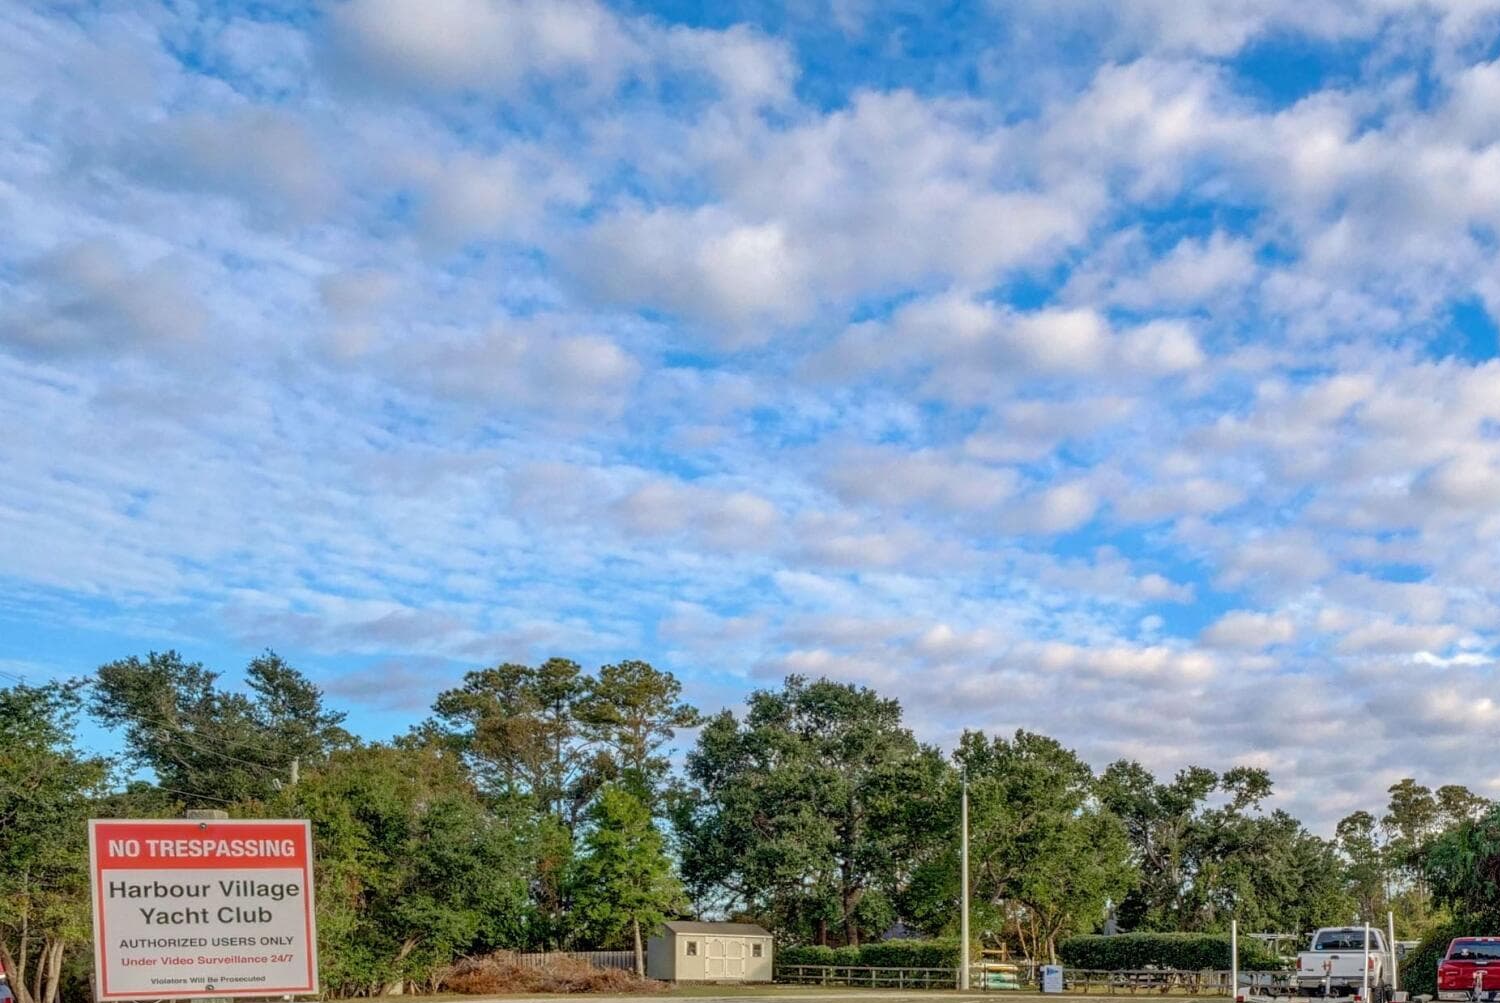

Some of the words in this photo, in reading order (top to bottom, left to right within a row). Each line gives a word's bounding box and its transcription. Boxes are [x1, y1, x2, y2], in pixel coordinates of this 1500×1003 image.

[109, 840, 139, 857] NO
[145, 838, 295, 857] TRESPASSING
[109, 881, 210, 899] Harbour
[217, 881, 300, 900] Village
[140, 907, 209, 925] Yacht
[218, 906, 272, 923] Club
[120, 938, 207, 948] AUTHORIZED
[212, 937, 256, 946] USERS
[261, 936, 294, 946] ONLY
[121, 957, 157, 966] Under
[161, 956, 194, 965] Video
[198, 955, 268, 964] Surveillance
[271, 954, 294, 963] 24/7
